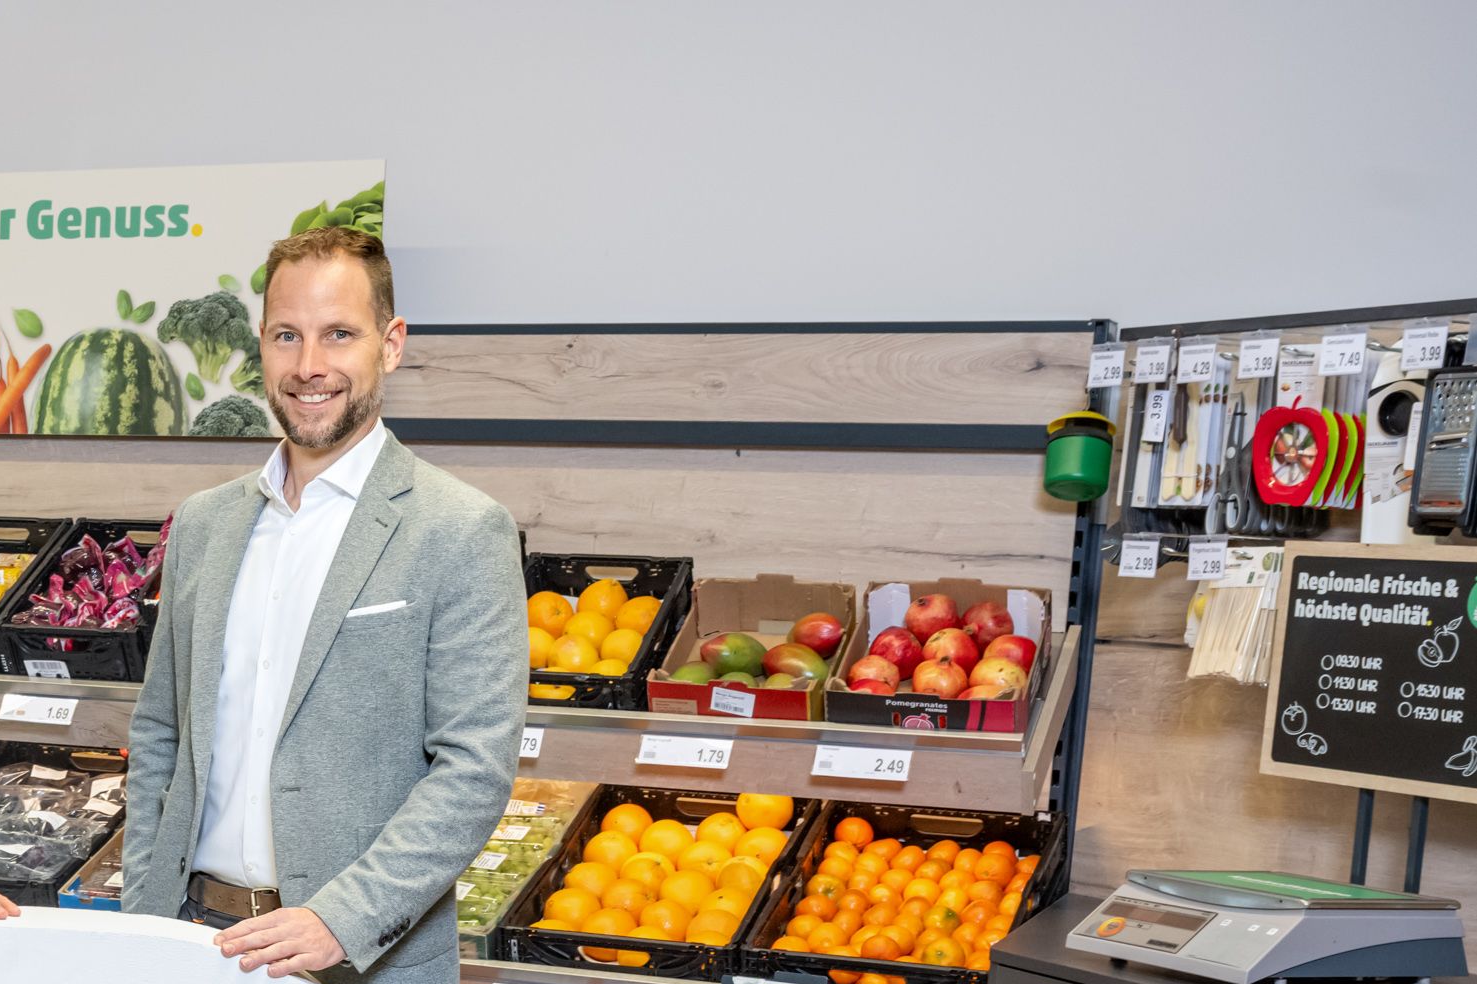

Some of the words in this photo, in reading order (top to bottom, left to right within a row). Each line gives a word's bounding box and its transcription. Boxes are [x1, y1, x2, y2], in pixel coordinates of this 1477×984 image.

[26, 200, 203, 240] Genuss.
[1339, 351, 1361, 368] 7.49
[1420, 346, 1441, 362] 3.99
[1193, 361, 1210, 374] 4.29
[1254, 357, 1272, 371] 3.99
[1103, 366, 1121, 380] 2.99
[1150, 394, 1163, 420] 3.99
[1135, 557, 1153, 570] 2.99
[1203, 560, 1221, 573] 2.99
[1297, 570, 1380, 595] Regionale
[1382, 573, 1442, 597] Frische
[1444, 578, 1459, 598] &
[1294, 598, 1357, 621] höchste
[1359, 603, 1433, 627] Qualität.
[1361, 656, 1383, 670] UHR
[1357, 678, 1378, 692] UHR
[1442, 686, 1466, 700] UHR
[885, 699, 948, 709] Pomegranates
[1355, 700, 1377, 714] UHR
[47, 706, 70, 720] 1.69
[1441, 708, 1464, 723] UHR
[696, 748, 724, 763] 1.79
[874, 758, 905, 774] 2.49
